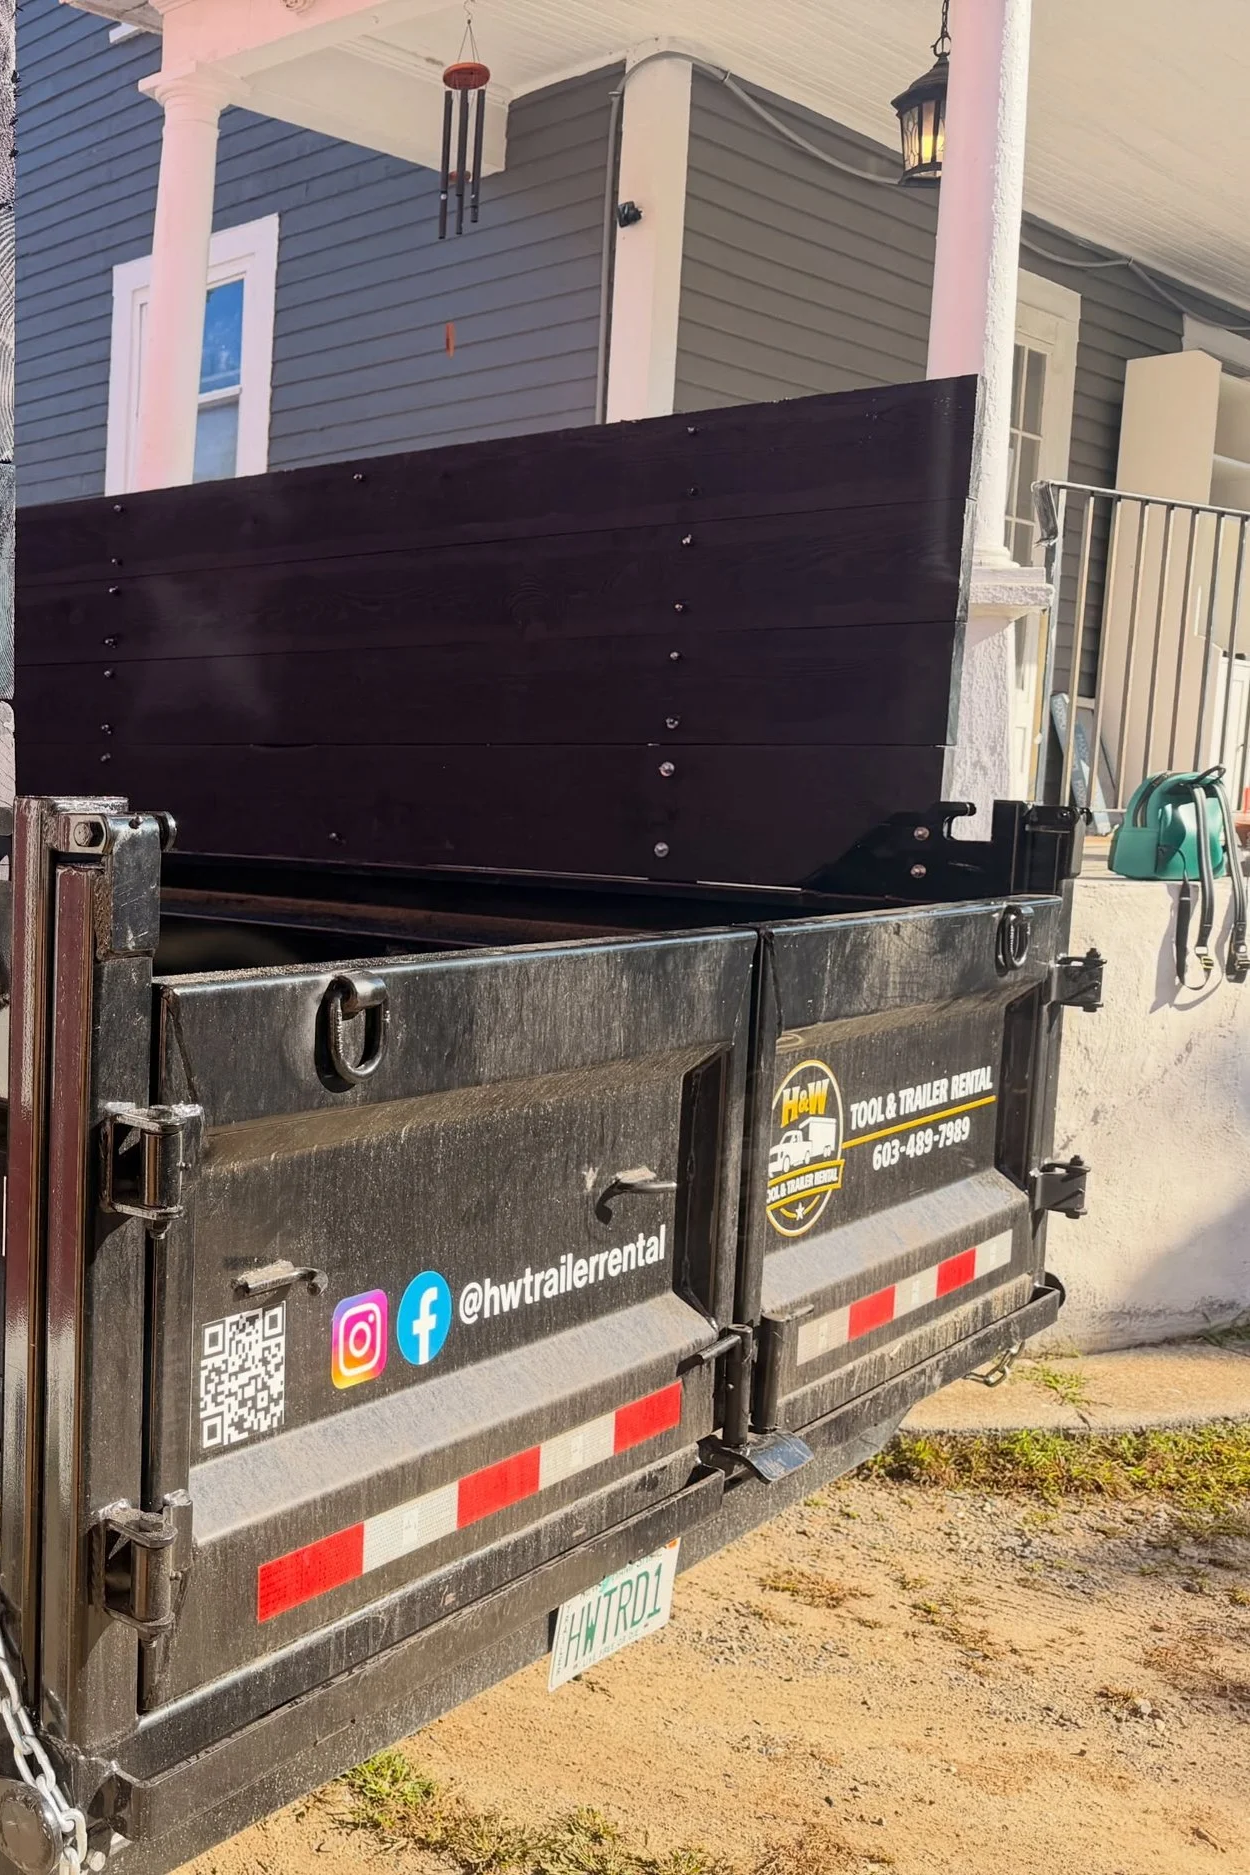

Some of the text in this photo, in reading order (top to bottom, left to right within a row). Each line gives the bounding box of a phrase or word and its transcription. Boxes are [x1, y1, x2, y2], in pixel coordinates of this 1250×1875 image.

[780, 1078, 830, 1128] H&W
[850, 1066, 993, 1131] TOOL & TRAILER RENTAL
[872, 1116, 971, 1171] 603-489-7989
[786, 1172, 814, 1195] TRAILER
[459, 1224, 666, 1326] @hwtrailerrental
[564, 1563, 662, 1668] HWTRD1
